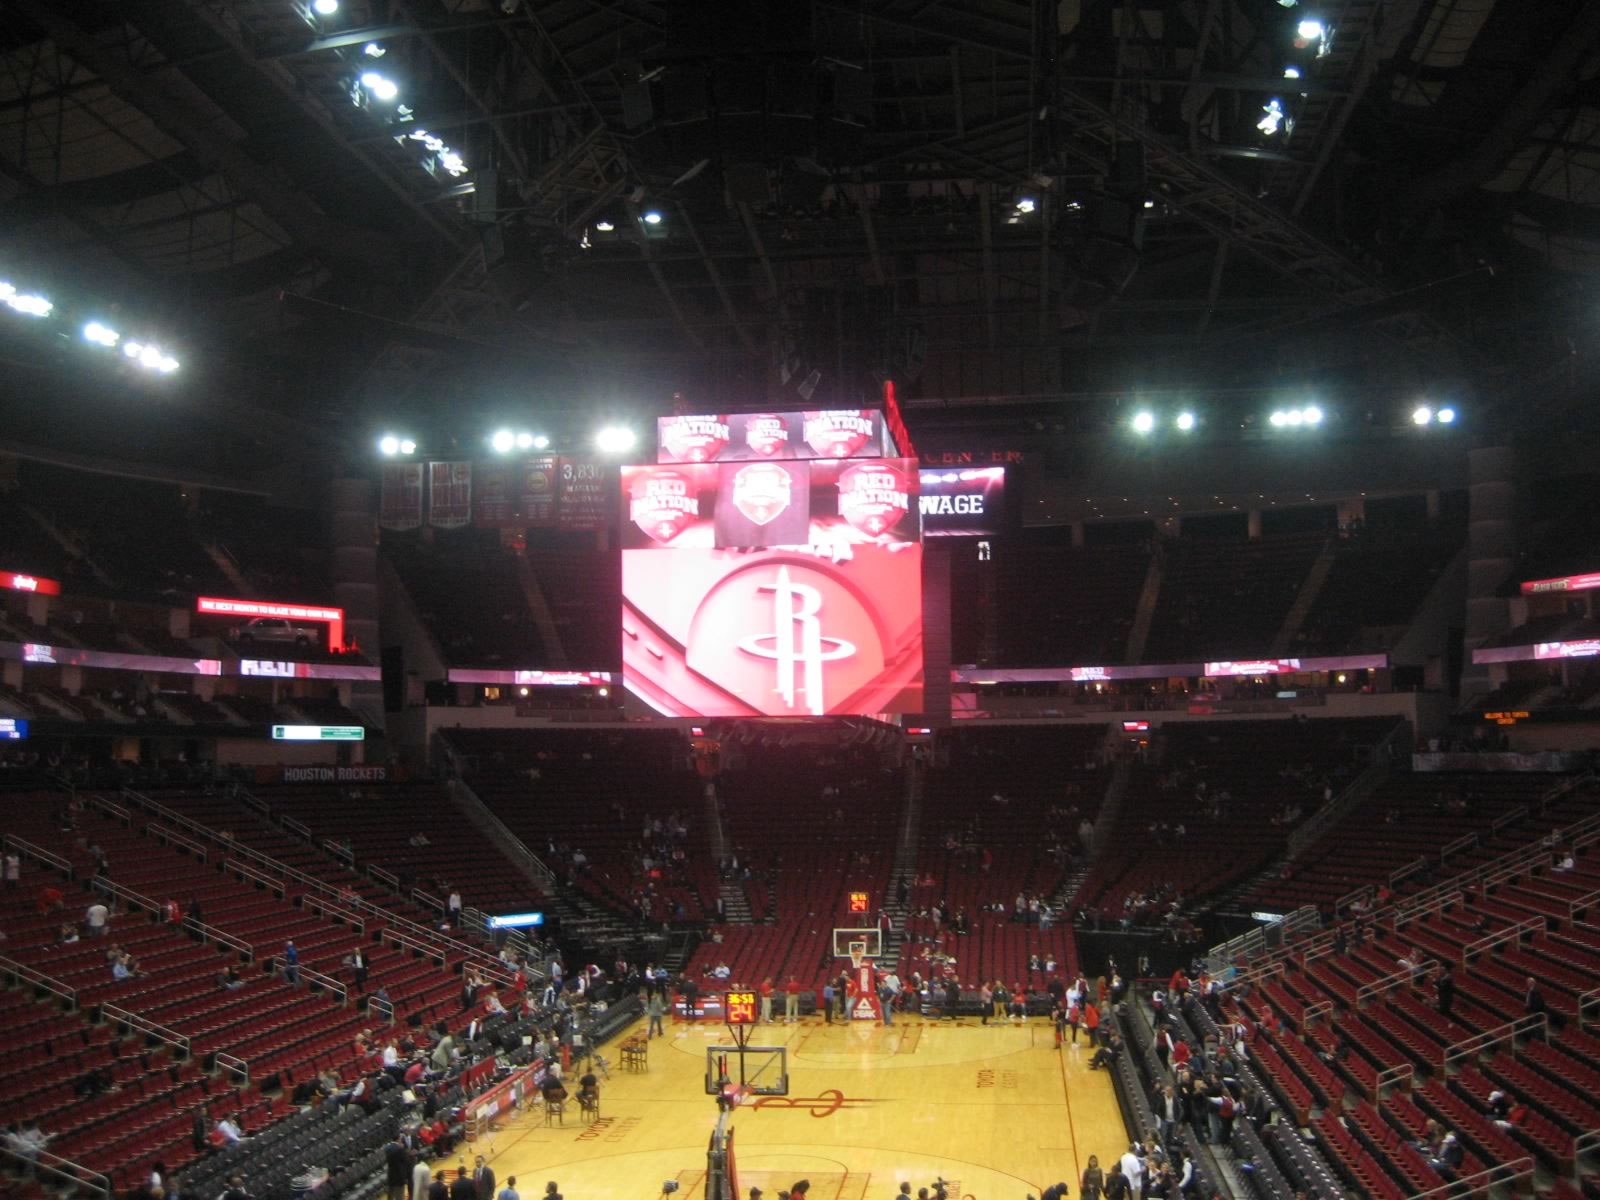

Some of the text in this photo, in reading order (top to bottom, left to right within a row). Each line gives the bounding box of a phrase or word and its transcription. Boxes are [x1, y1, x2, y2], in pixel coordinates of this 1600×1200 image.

[646, 479, 686, 496] RED
[855, 473, 895, 490] RED
[630, 495, 698, 518] NATION
[838, 492, 908, 515] NATION
[285, 767, 386, 781] HOUSTON ROCKETS
[731, 1004, 753, 1020] 24
[853, 1010, 876, 1018] PEAK
